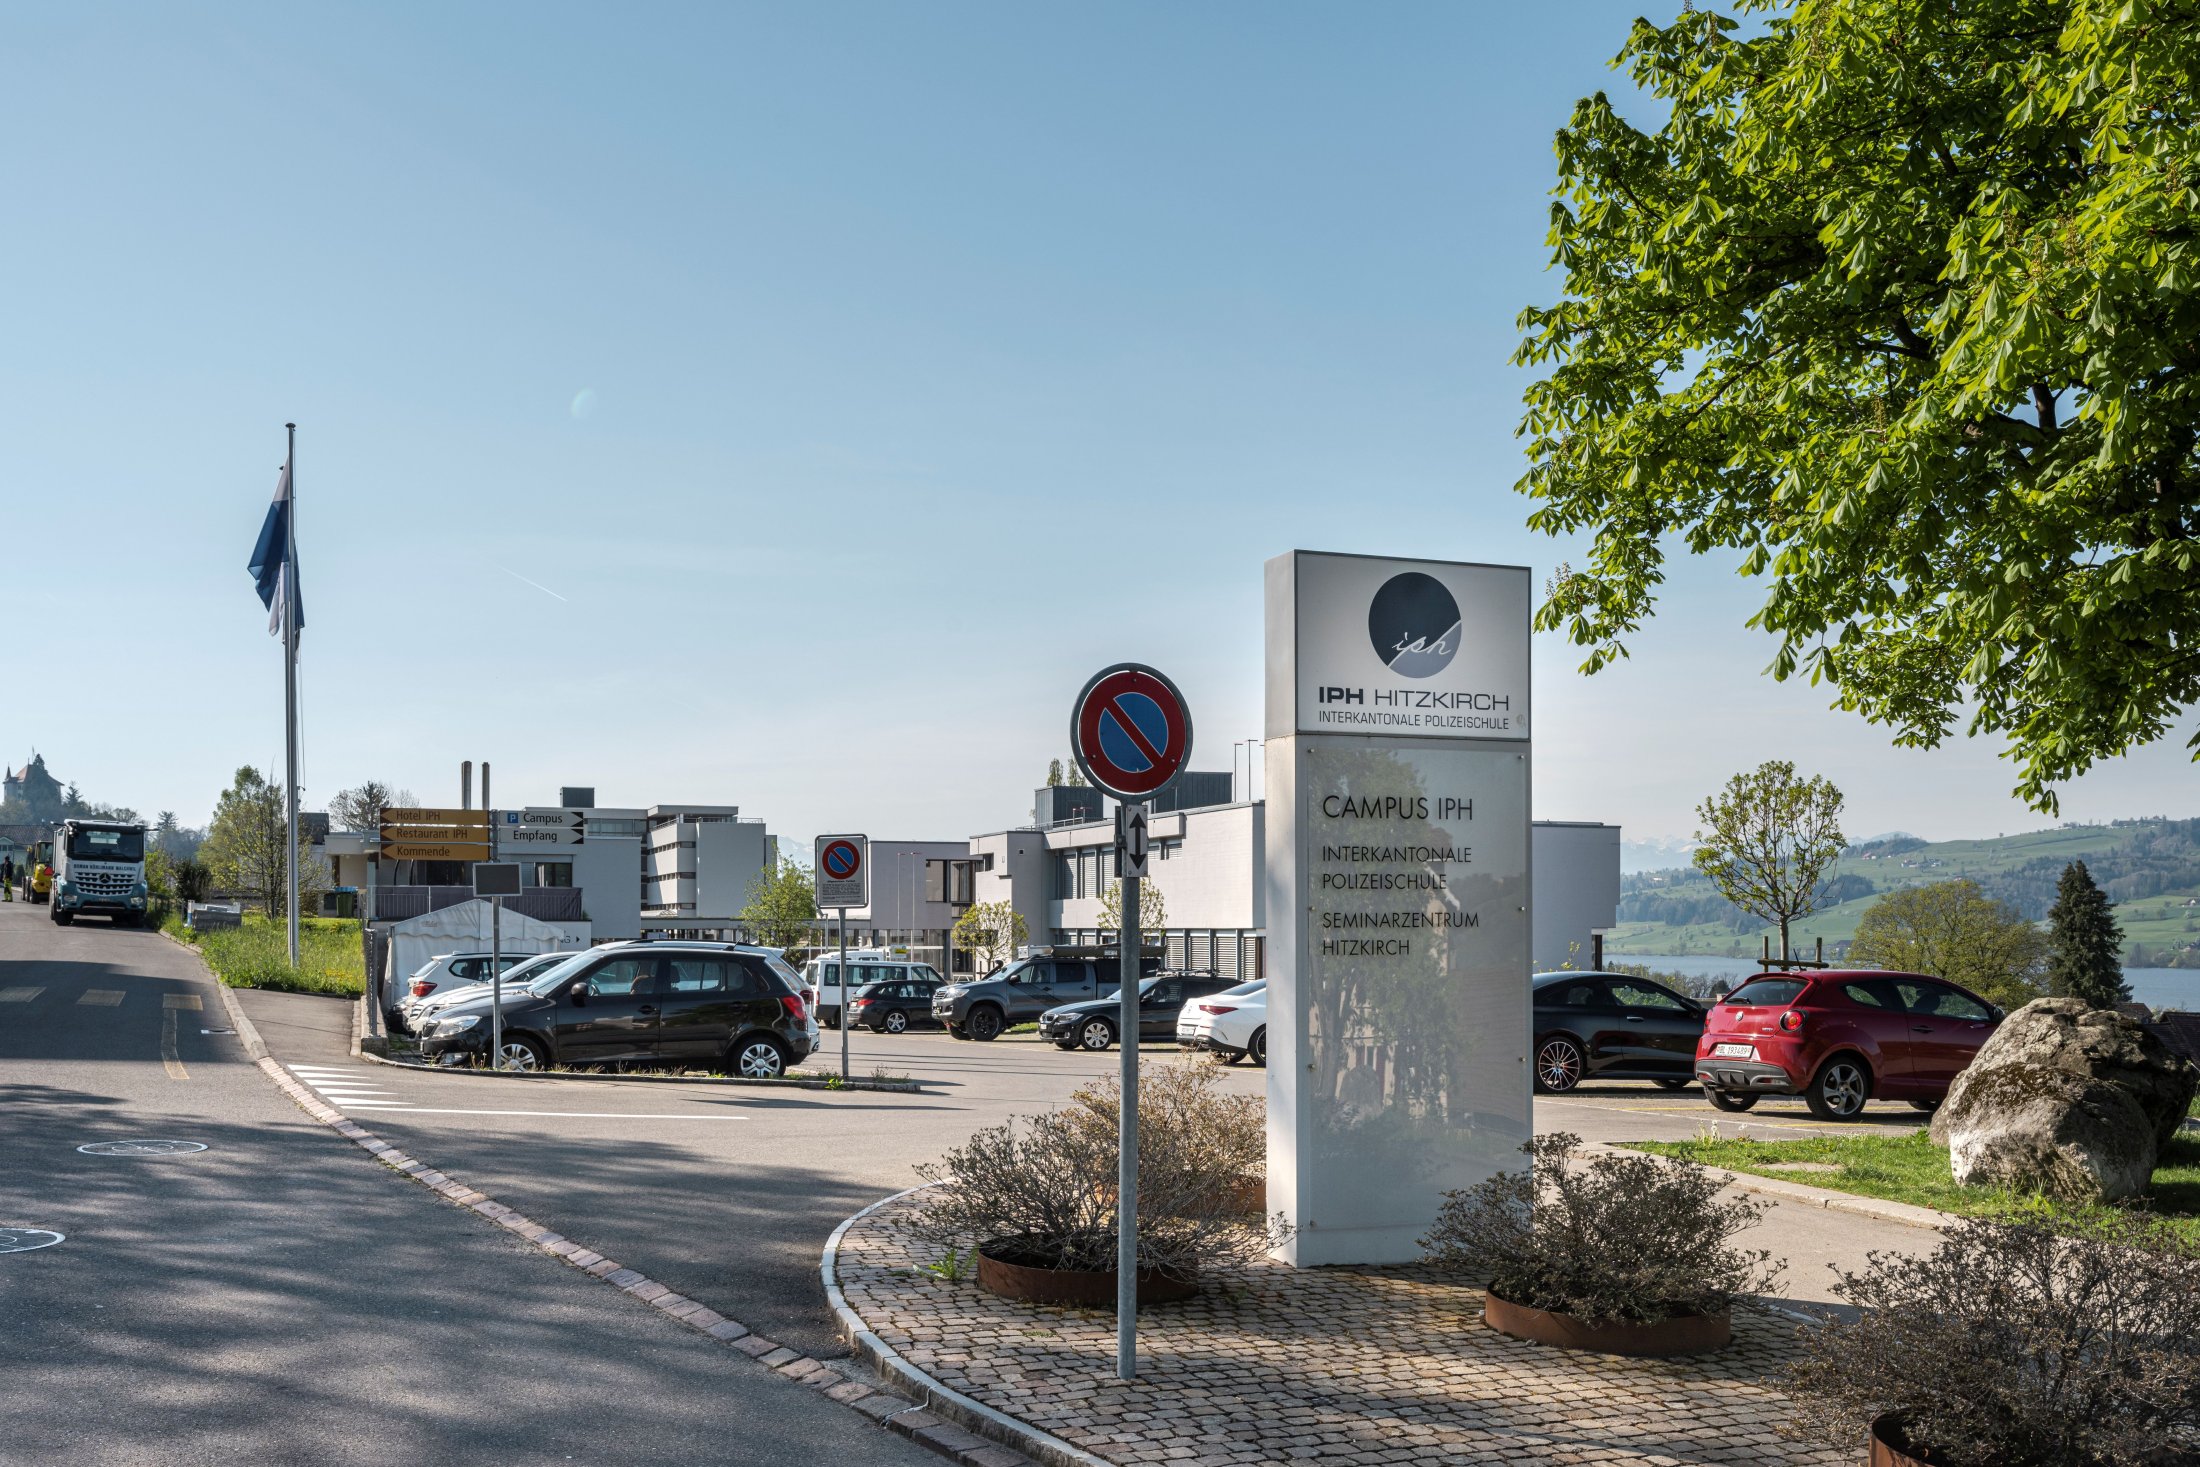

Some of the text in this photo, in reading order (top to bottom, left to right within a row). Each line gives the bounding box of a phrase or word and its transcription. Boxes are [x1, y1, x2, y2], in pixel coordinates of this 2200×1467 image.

[1319, 686, 1509, 711] IPH HITZKIRCH
[1319, 710, 1509, 730] INTERKANTONALE POLIZEISCHULE
[1322, 795, 1473, 820] CAMPUS IPH
[396, 811, 441, 821] Hotel IPH
[523, 813, 563, 825] Campus
[396, 829, 468, 839] Restaurant IPH
[513, 830, 558, 843] Empfang
[397, 846, 450, 857] Kommende
[1322, 846, 1472, 863] INTERKANTONALE
[1322, 873, 1447, 890] POLIZEISCHULE
[1322, 912, 1479, 928] SEMINARZENTRUM
[1322, 939, 1410, 956] HITZKIRCH
